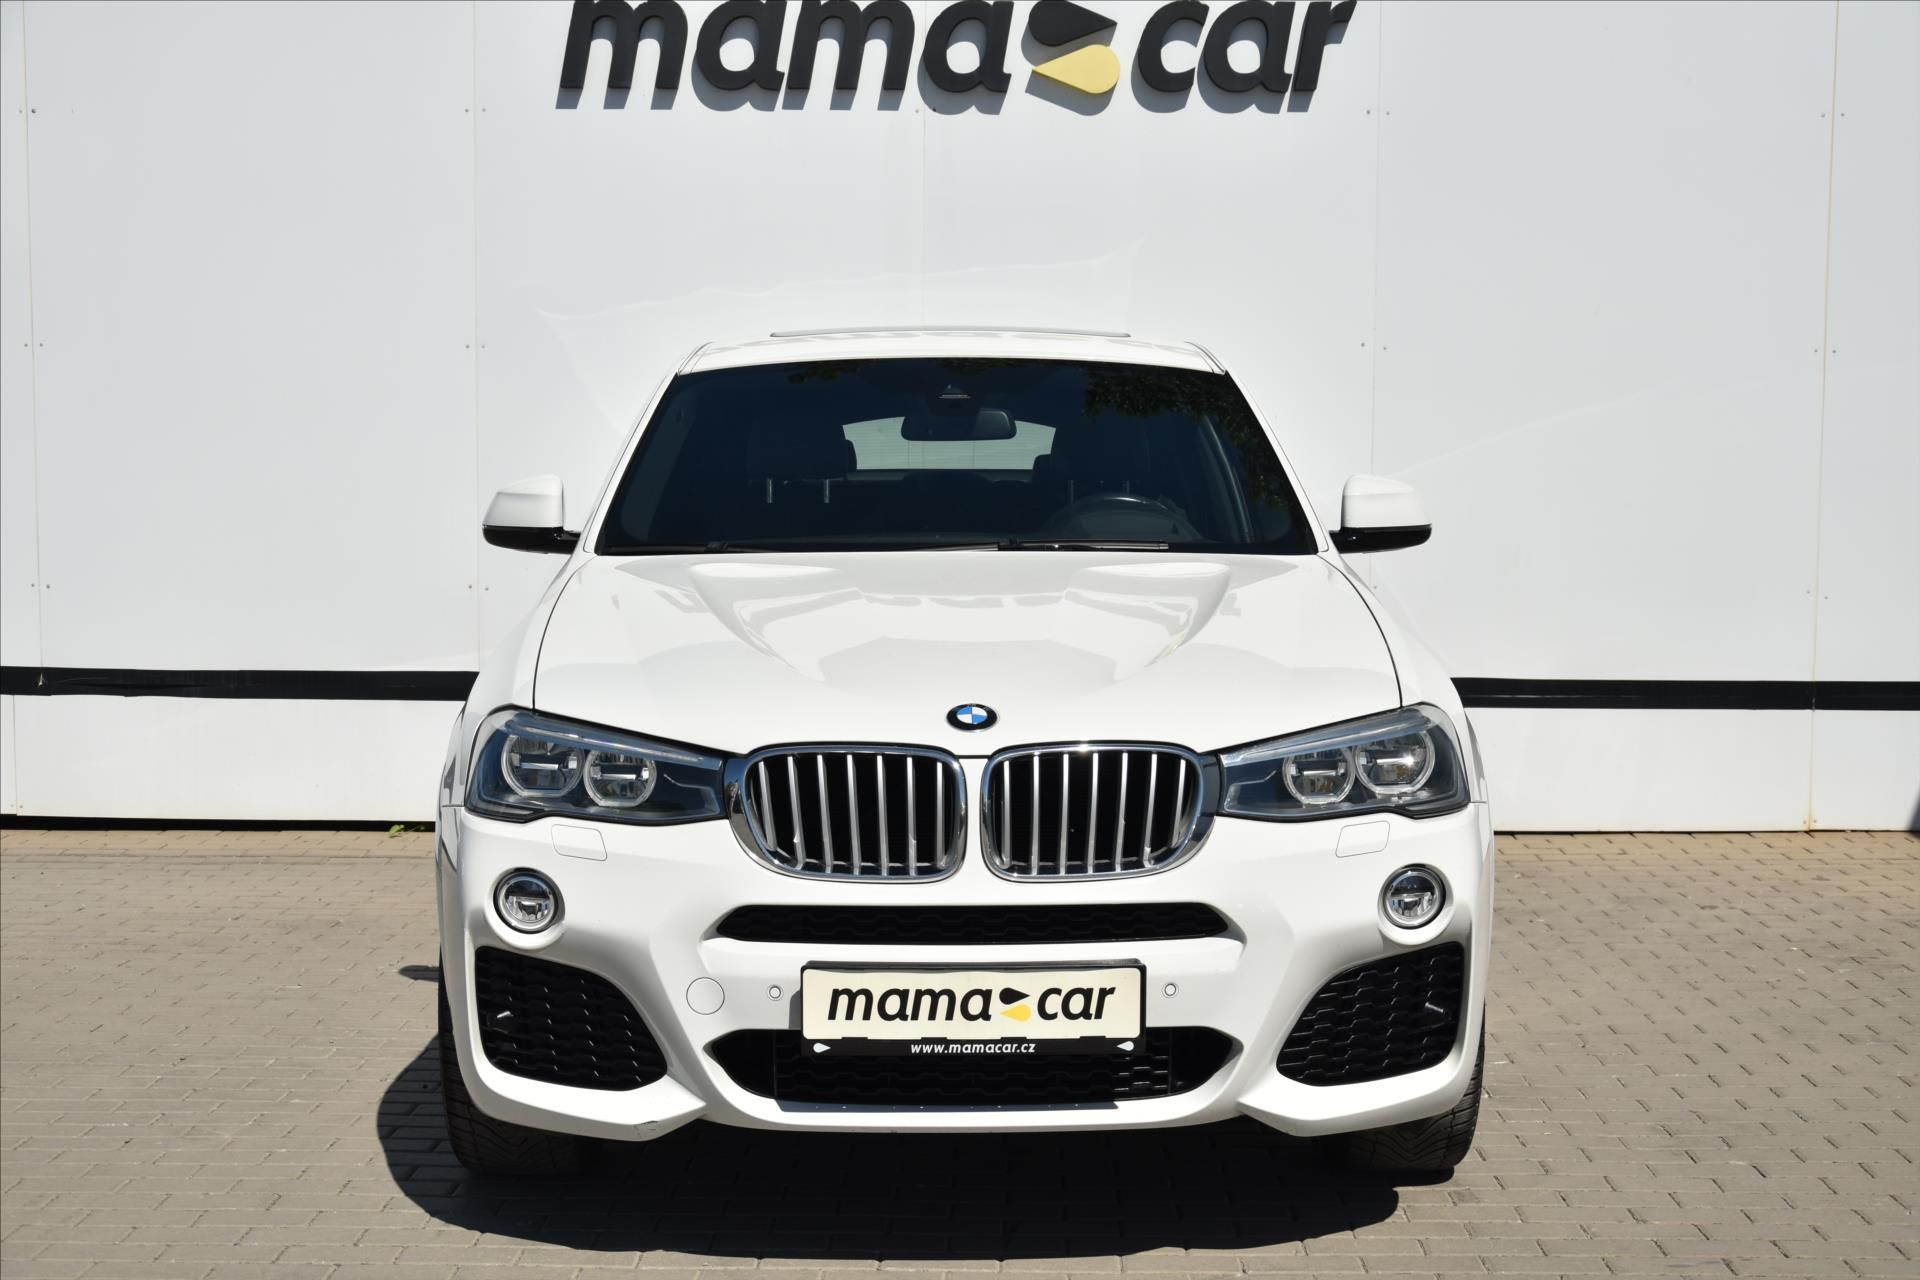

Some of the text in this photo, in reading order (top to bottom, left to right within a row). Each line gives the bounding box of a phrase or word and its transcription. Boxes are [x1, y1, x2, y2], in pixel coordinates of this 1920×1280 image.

[560, 0, 1357, 94] mama car
[827, 986, 1116, 1021] mama car
[910, 1041, 1036, 1053] www.mamacar.cz
